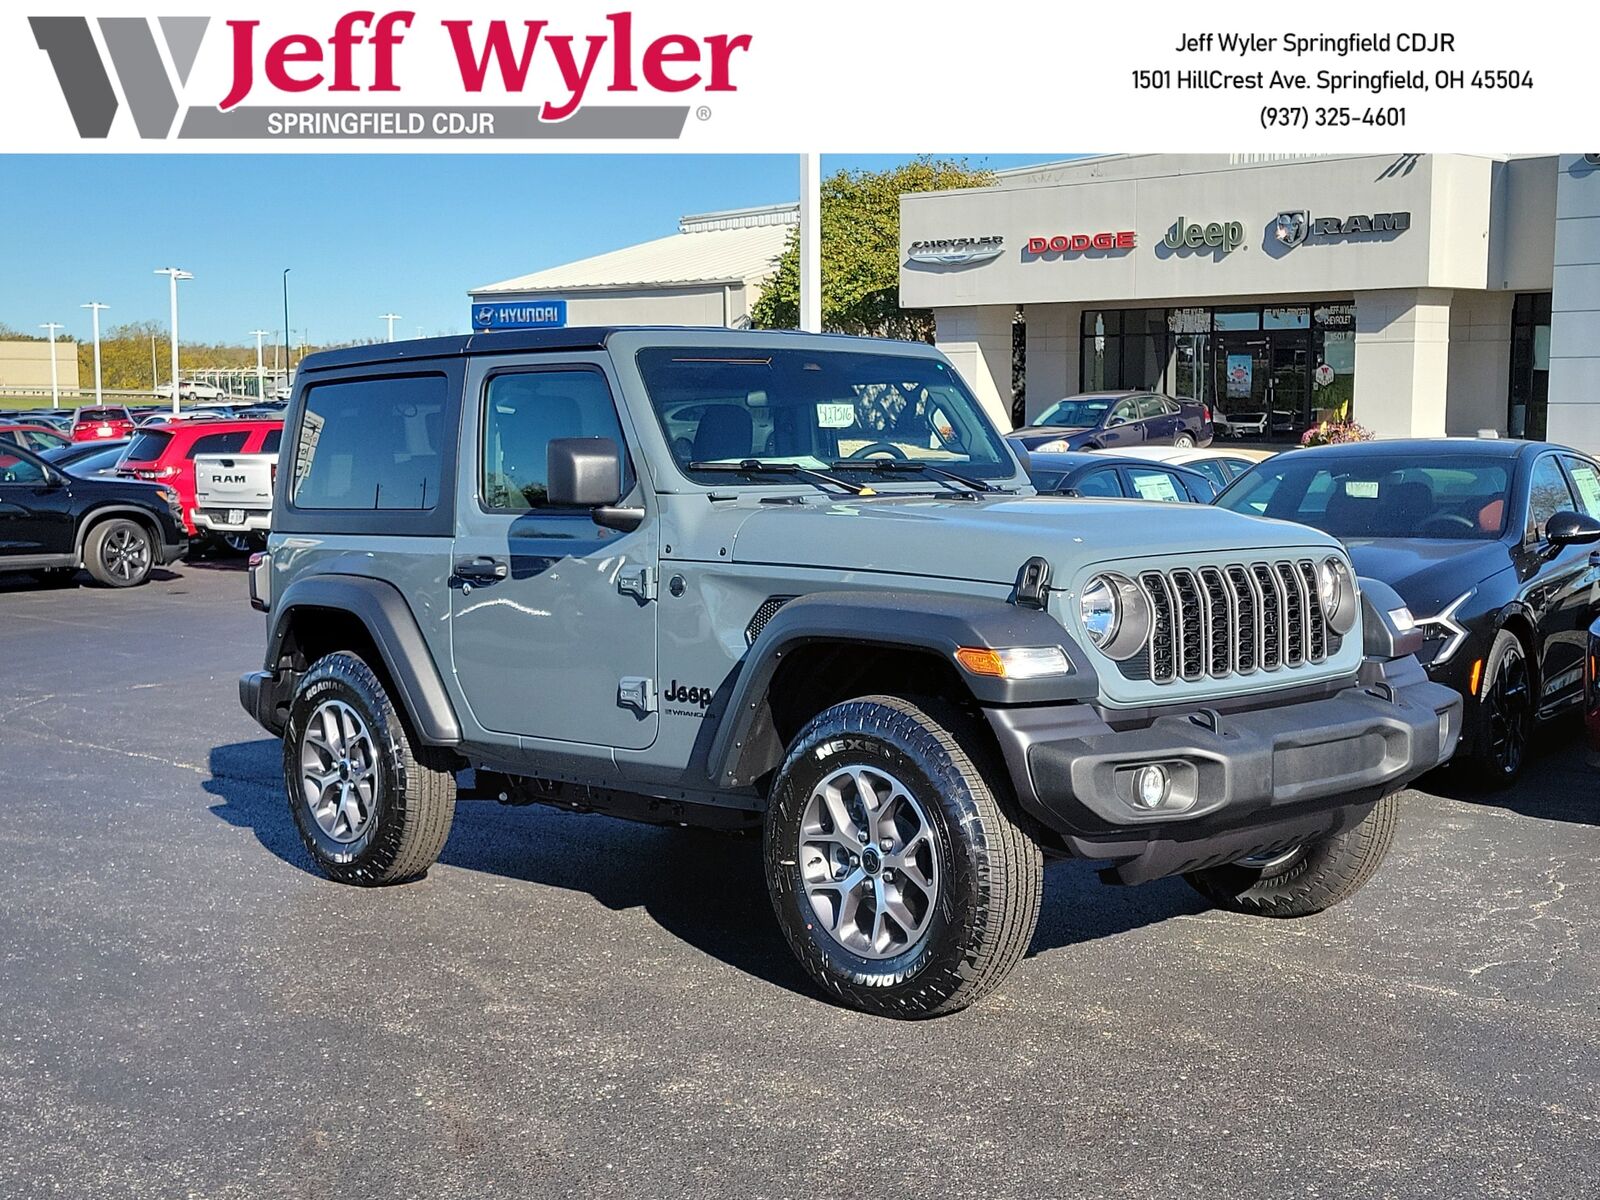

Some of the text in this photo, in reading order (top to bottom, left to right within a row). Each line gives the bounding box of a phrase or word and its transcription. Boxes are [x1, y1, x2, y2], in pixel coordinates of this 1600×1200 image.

[1165, 216, 1243, 252] Jeep
[1314, 212, 1410, 235] RAM
[911, 236, 1004, 249] CHRYSLER
[1028, 231, 1136, 253] DODGE
[500, 307, 558, 323] HYUNDAI
[212, 475, 246, 484] RAM
[664, 680, 712, 709] Jeep
